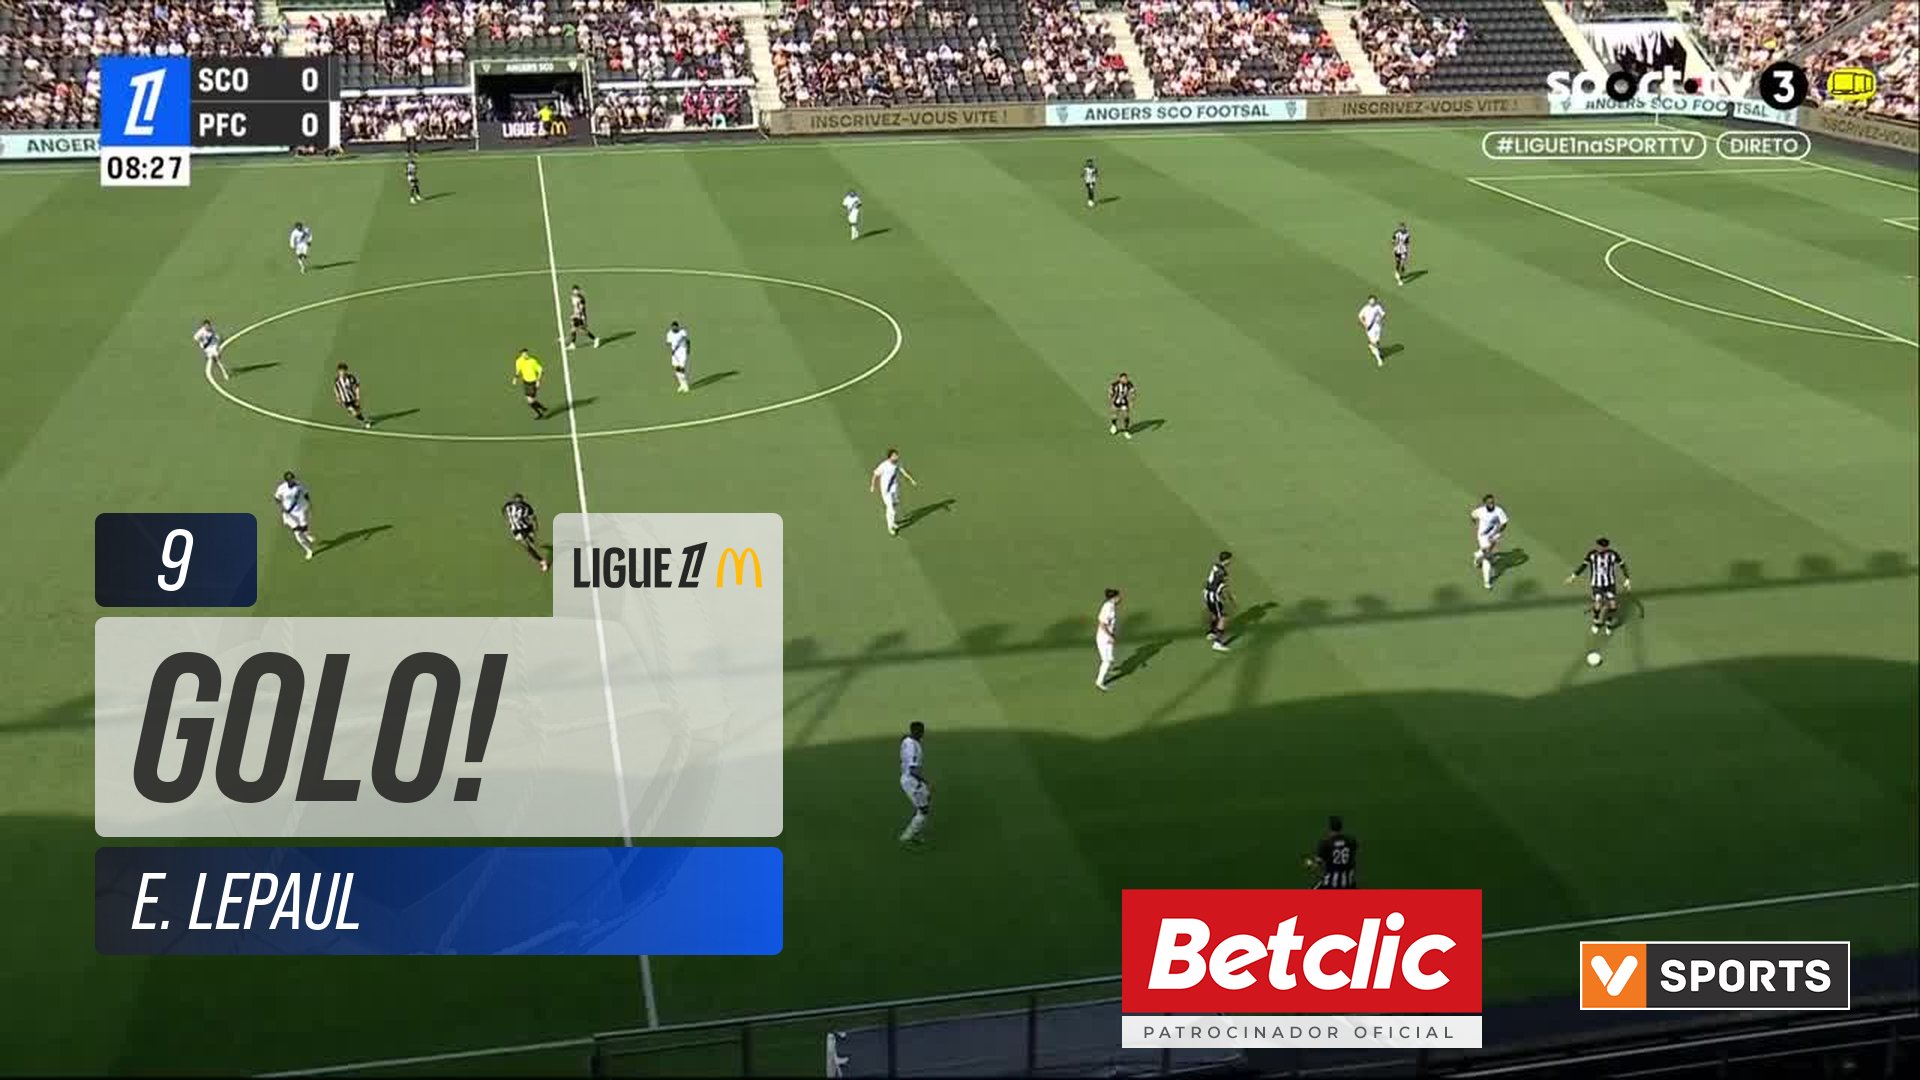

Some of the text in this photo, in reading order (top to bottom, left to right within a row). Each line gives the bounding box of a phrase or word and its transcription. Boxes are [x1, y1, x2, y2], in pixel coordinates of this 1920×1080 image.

[1084, 102, 1270, 121] ANGERS SCO FOOTSAL
[1342, 99, 1473, 116] INSCRIVEZ-VOUS
[810, 110, 958, 129] INSCRIVEZ-VOUS
[962, 109, 998, 124] VITE
[502, 121, 538, 138] LIGUE
[26, 138, 101, 153] ANGER
[1333, 847, 1350, 865] 26
